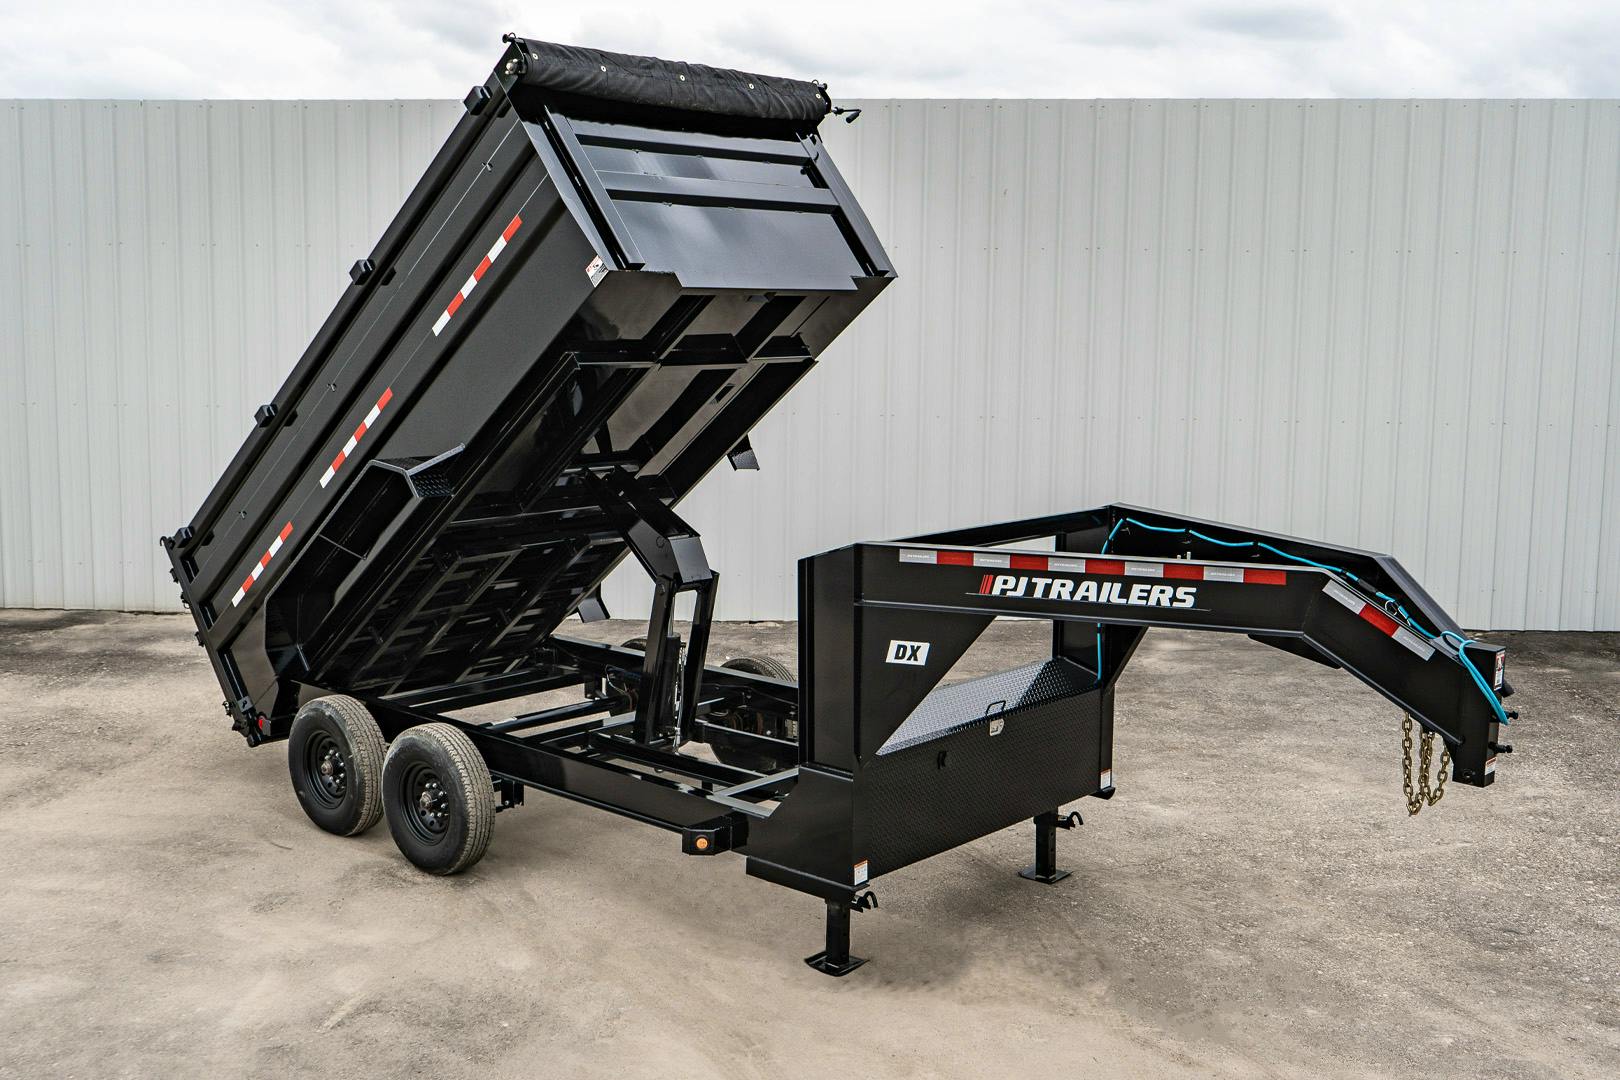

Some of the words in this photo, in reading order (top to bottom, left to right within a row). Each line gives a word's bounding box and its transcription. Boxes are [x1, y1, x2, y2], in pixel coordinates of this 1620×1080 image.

[991, 575, 1027, 597] PJ
[1031, 577, 1197, 608] TRAILERS
[894, 644, 922, 661] DX
